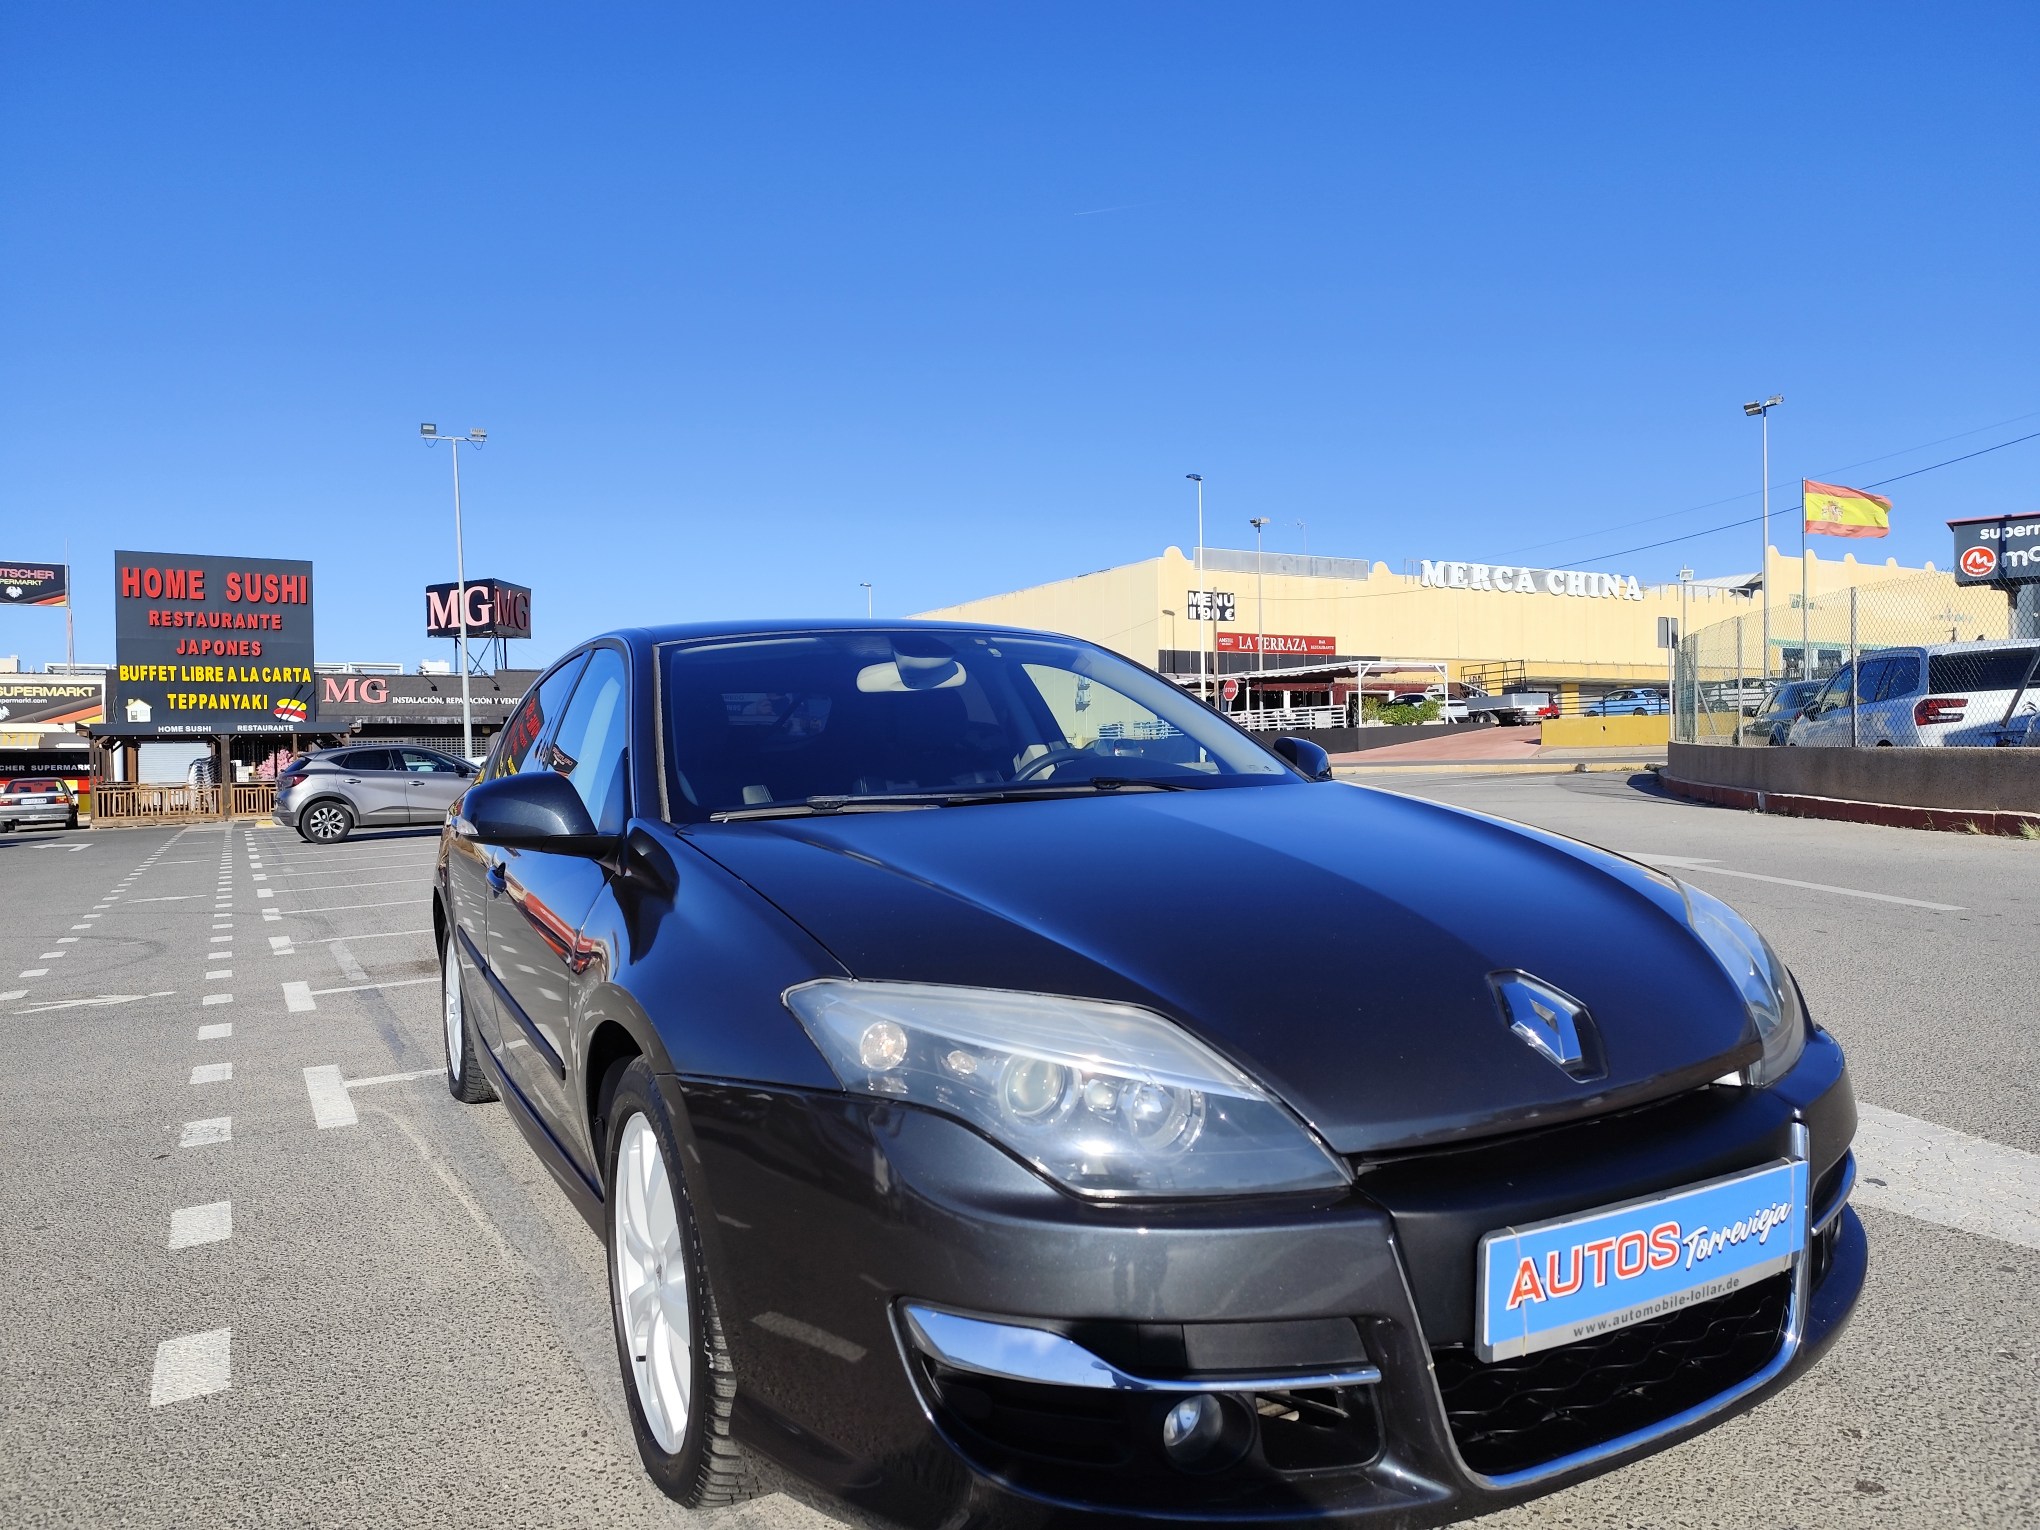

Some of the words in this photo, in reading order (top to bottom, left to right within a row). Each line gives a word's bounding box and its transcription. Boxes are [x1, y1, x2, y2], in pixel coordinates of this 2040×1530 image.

[122, 566, 206, 600] HOME
[225, 571, 307, 604] SUSHI
[1421, 559, 1536, 594] MERCA
[1546, 568, 1643, 601] CHINA
[426, 585, 493, 630] MG
[494, 584, 529, 631] MG
[1224, 607, 1235, 621] €
[148, 610, 282, 630] RESTAURANTE
[176, 639, 262, 657] JAPONES
[1238, 635, 1253, 649] LA
[1255, 636, 1308, 651] TERRAZA
[119, 665, 177, 682] BUFFET
[181, 665, 224, 682] LIBRE
[227, 667, 237, 682] A
[240, 667, 259, 682] LA
[262, 667, 312, 683] CARTA
[0, 686, 95, 697] SUPERMARKT
[322, 678, 390, 704] MG
[392, 695, 445, 705] INSTALACIÓN,
[446, 696, 492, 705] REPAACIÓN
[167, 694, 268, 710] TEPPANYAKI
[158, 725, 184, 733] HOME
[185, 725, 212, 733] SUSHI
[237, 724, 294, 732] RESTAURANTE
[1505, 1220, 1681, 1311] AUTOS
[1683, 1202, 1793, 1269] Torrevieja
[1573, 1276, 1740, 1337] www.automobile-lollar.de
